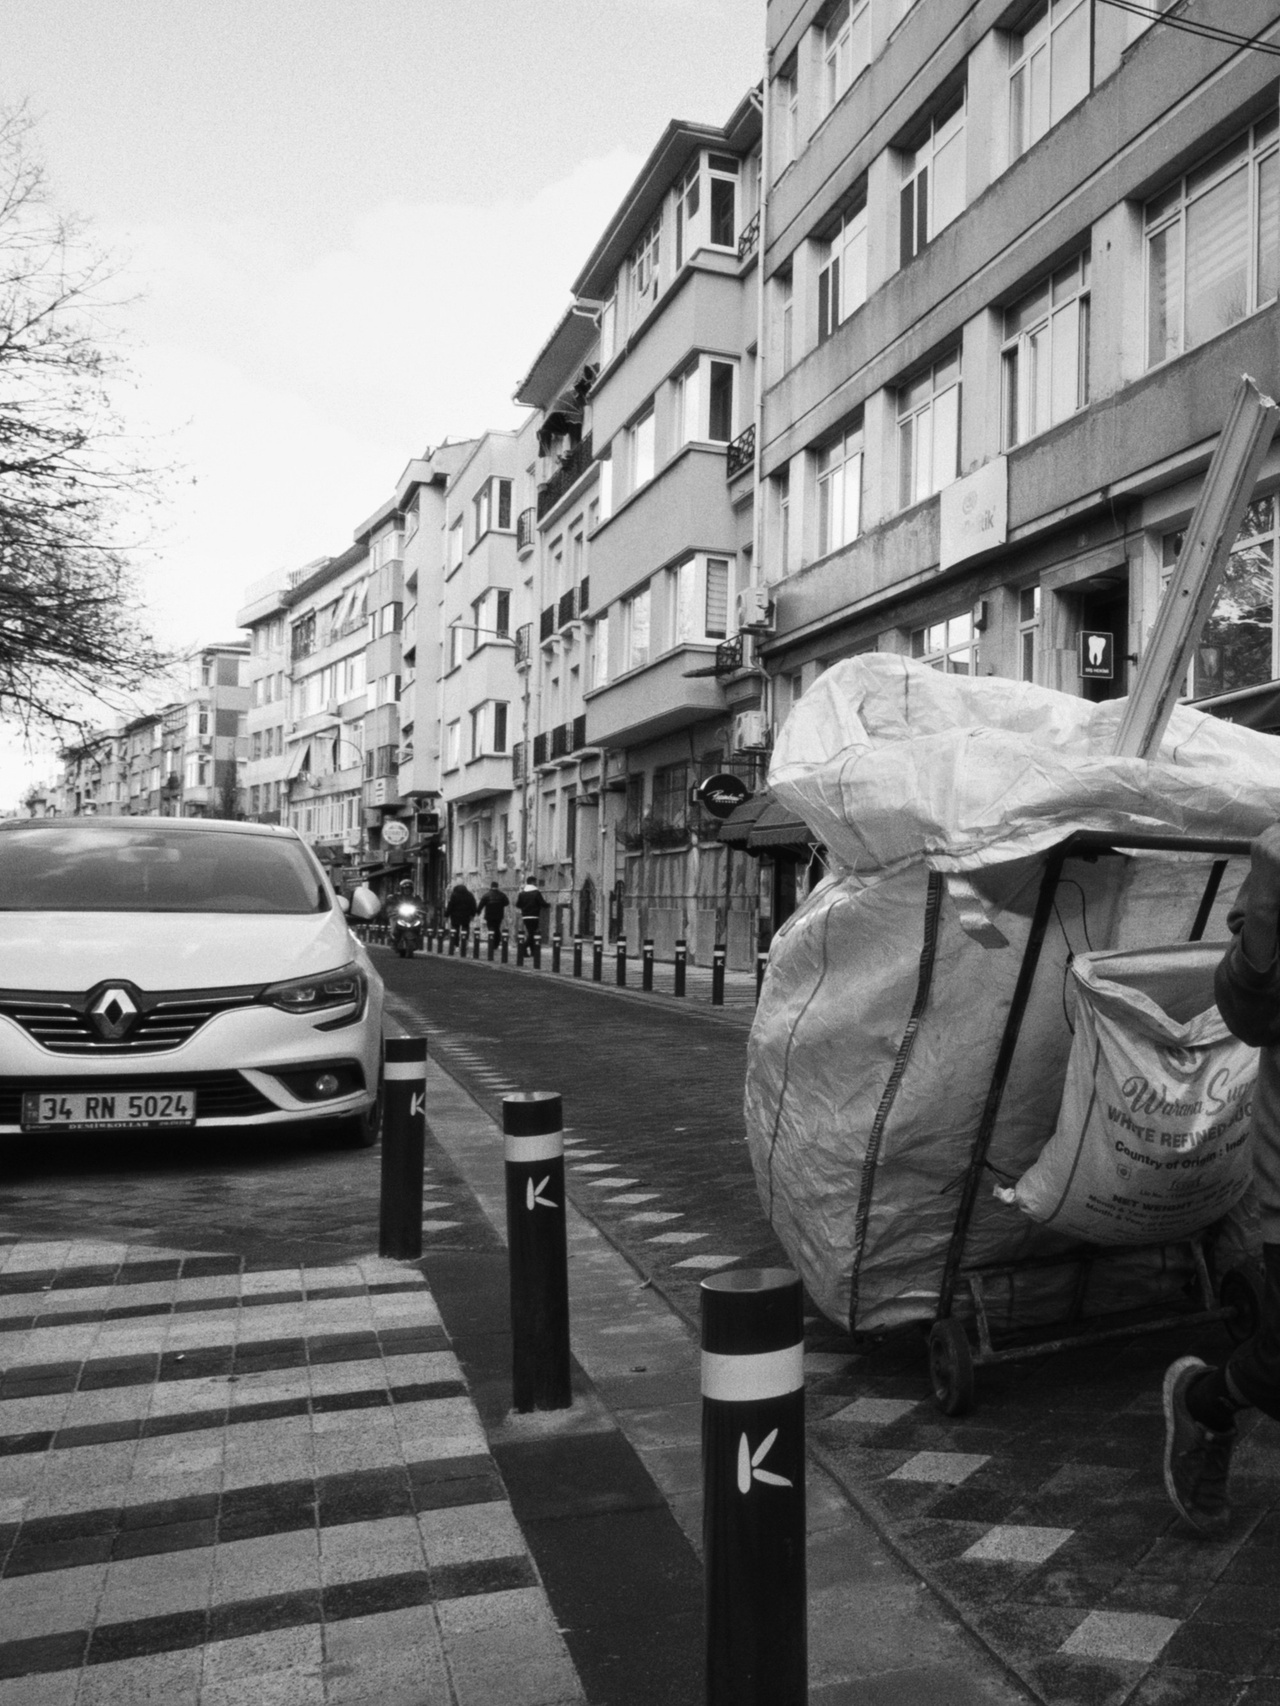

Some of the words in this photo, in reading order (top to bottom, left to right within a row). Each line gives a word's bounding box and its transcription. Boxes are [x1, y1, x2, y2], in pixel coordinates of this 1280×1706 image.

[42, 1097, 73, 1120] 34
[86, 1096, 115, 1119] RN
[128, 1095, 188, 1118] 5024
[1160, 1122, 1227, 1148] REFINED
[1115, 1140, 1162, 1170] Country
[1165, 1159, 1180, 1170] of
[1181, 1151, 1216, 1169] Origin
[526, 1175, 559, 1211] K
[1112, 1194, 1139, 1208] NET
[1142, 1201, 1193, 1212] WEIGHT
[737, 1427, 793, 1494] K
